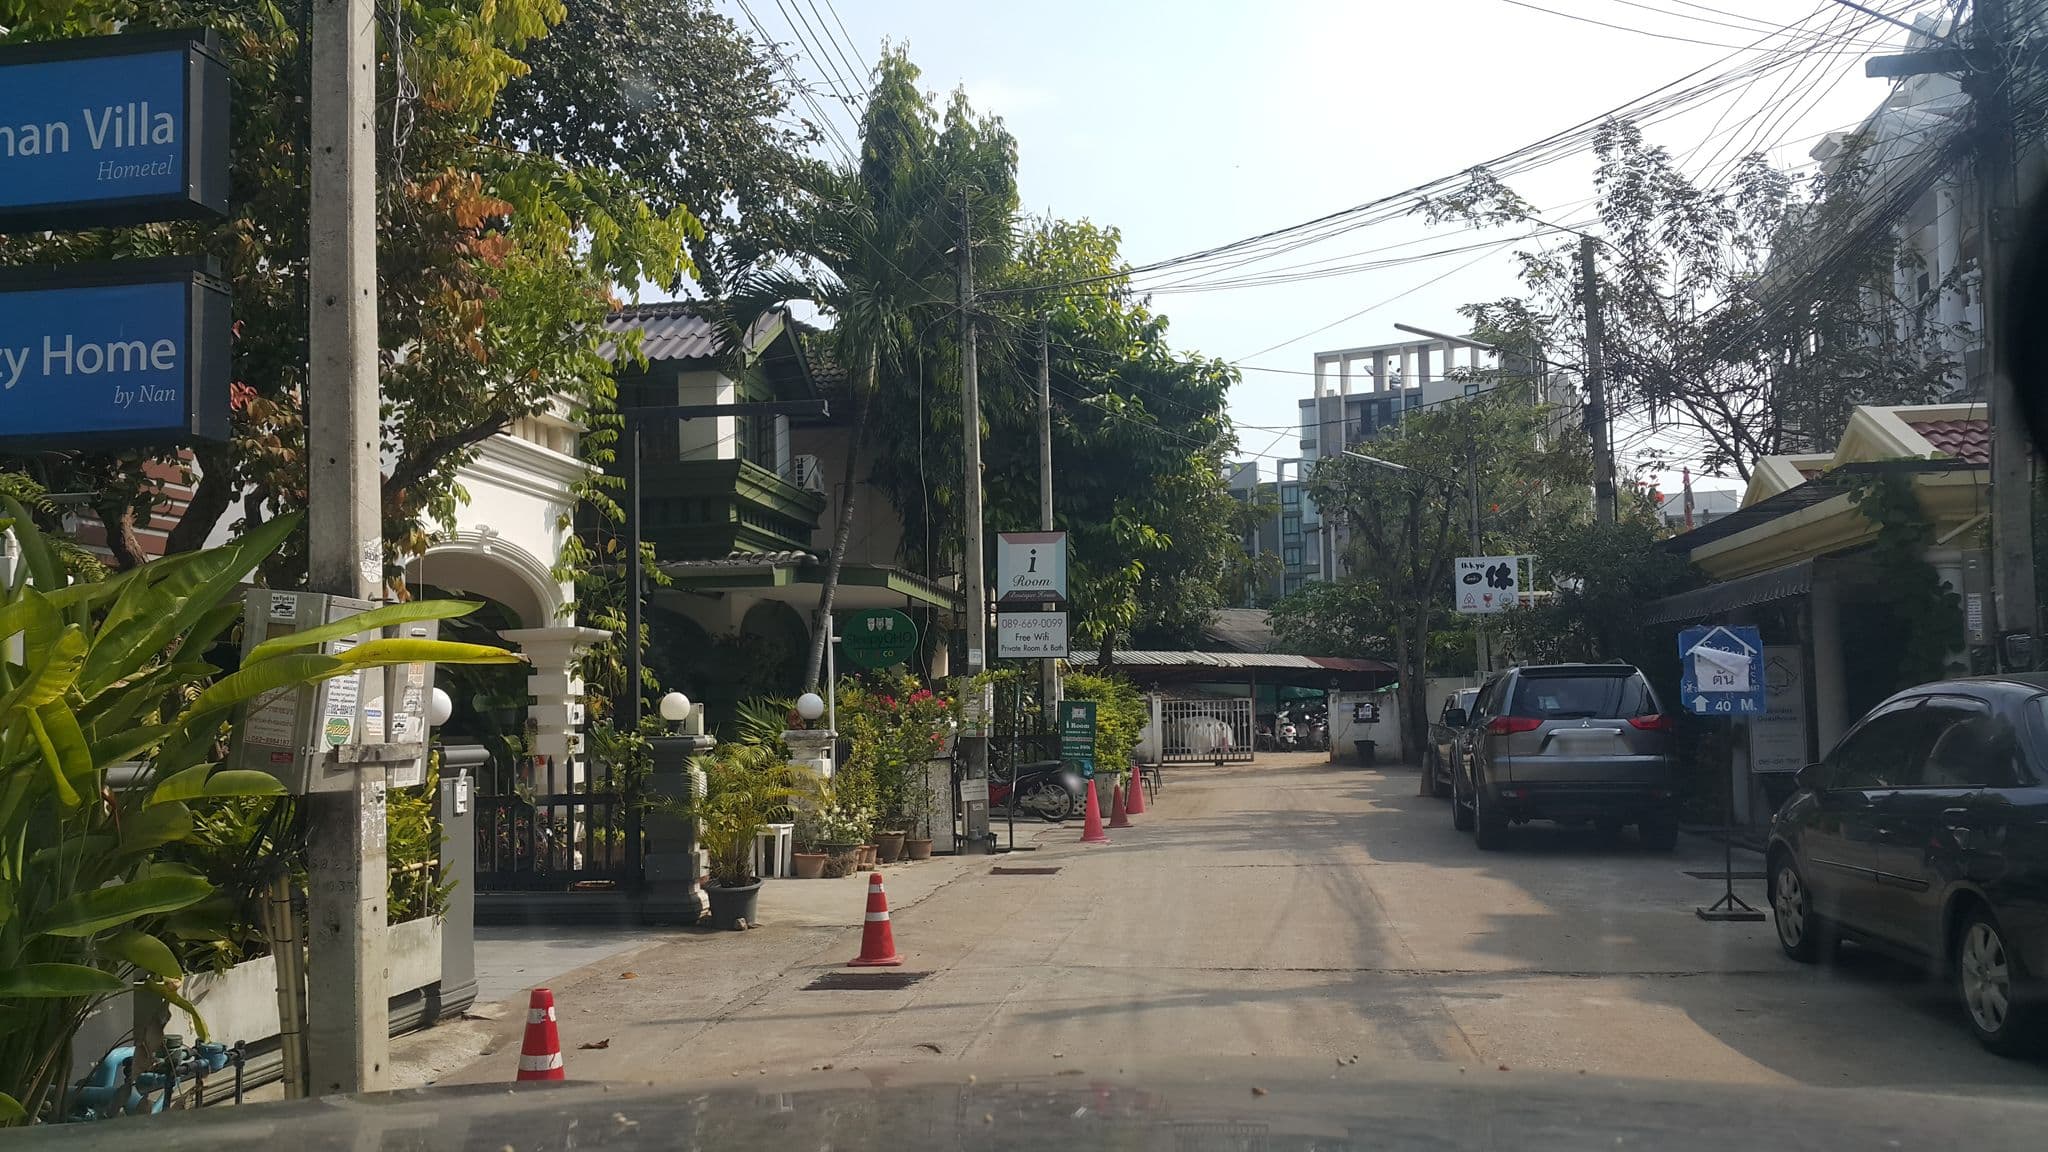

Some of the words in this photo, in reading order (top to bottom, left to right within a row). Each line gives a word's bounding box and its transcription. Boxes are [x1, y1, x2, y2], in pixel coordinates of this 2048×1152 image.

[83, 101, 175, 151] Villa
[96, 154, 174, 182] Hometel
[0, 347, 30, 390] y
[42, 333, 177, 377] Home
[113, 385, 134, 410] by
[138, 385, 176, 404] Nan
[1027, 548, 1037, 573] i
[1013, 574, 1052, 587] Room
[1001, 618, 1063, 629] 089-669-0099
[1015, 633, 1031, 642] Free
[1034, 632, 1049, 641] Wifi
[1001, 644, 1021, 652] Private
[1023, 644, 1040, 652] Room
[1042, 644, 1048, 652] &
[1050, 644, 1063, 652] Bath
[1715, 701, 1732, 712] 40
[1740, 698, 1758, 711] M.
